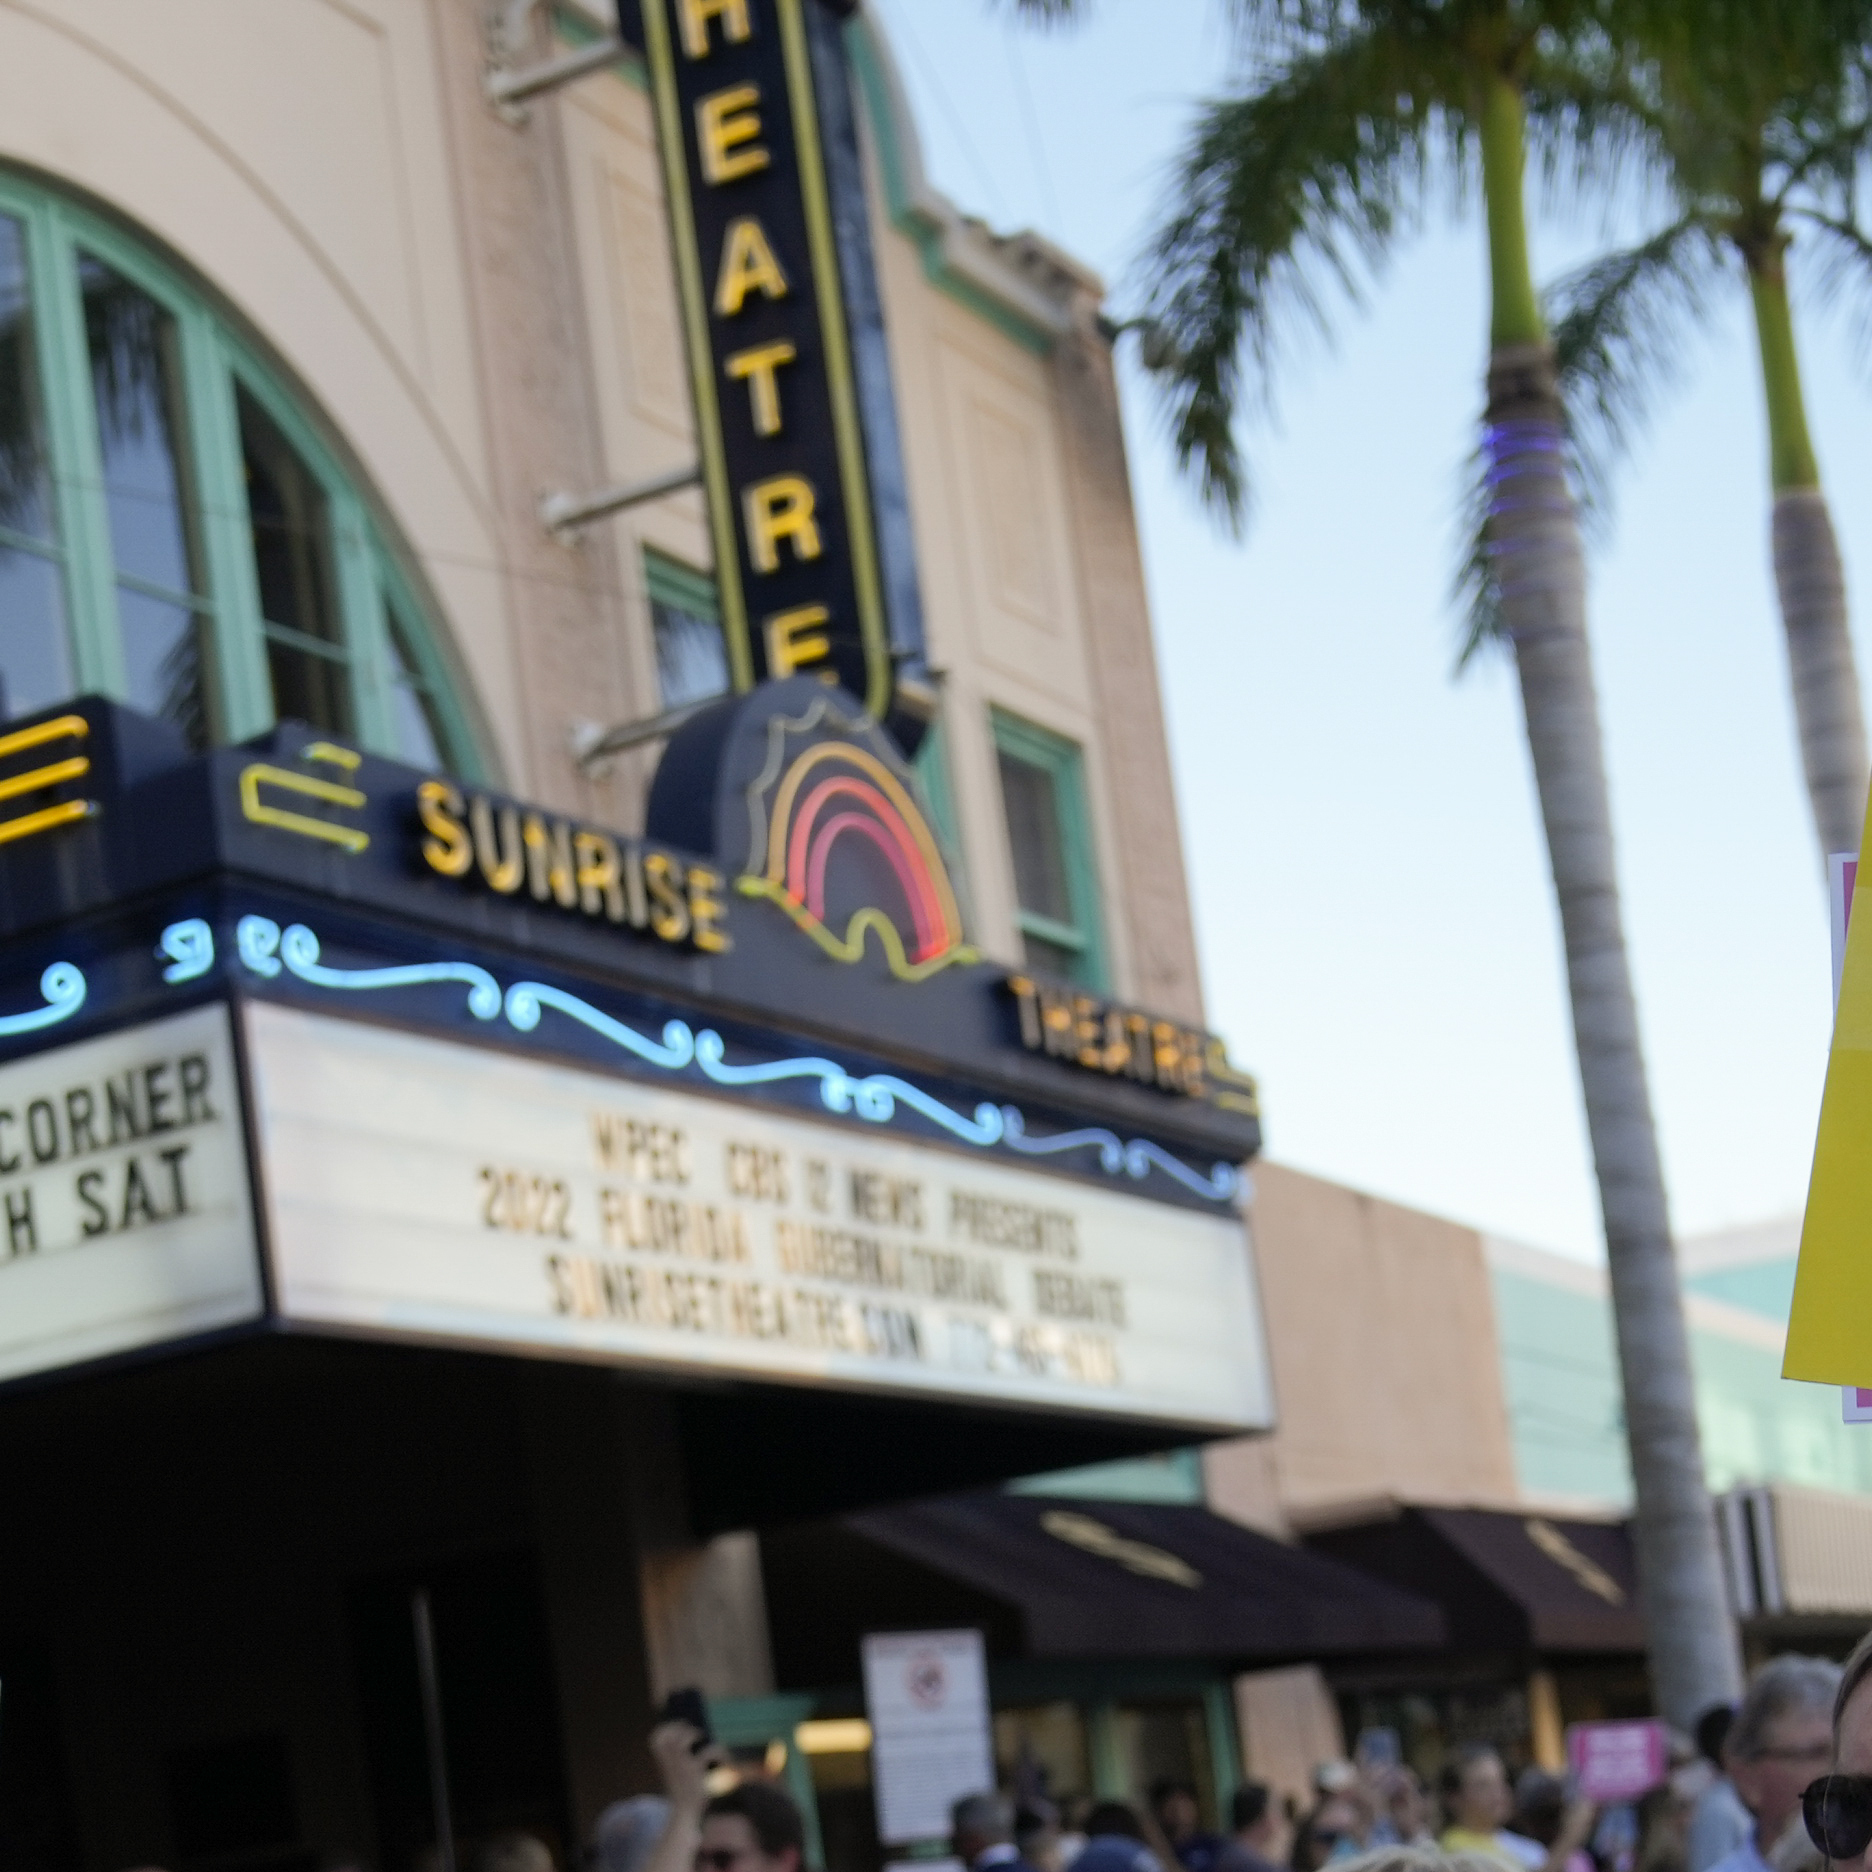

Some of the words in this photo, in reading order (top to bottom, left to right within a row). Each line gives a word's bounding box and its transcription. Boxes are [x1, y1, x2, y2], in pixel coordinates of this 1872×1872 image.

[416, 780, 733, 955] SUNRISE
[1005, 974, 1208, 1097] THEATRE
[78, 1146, 196, 1241] SAT
[478, 1164, 571, 1240] 2022
